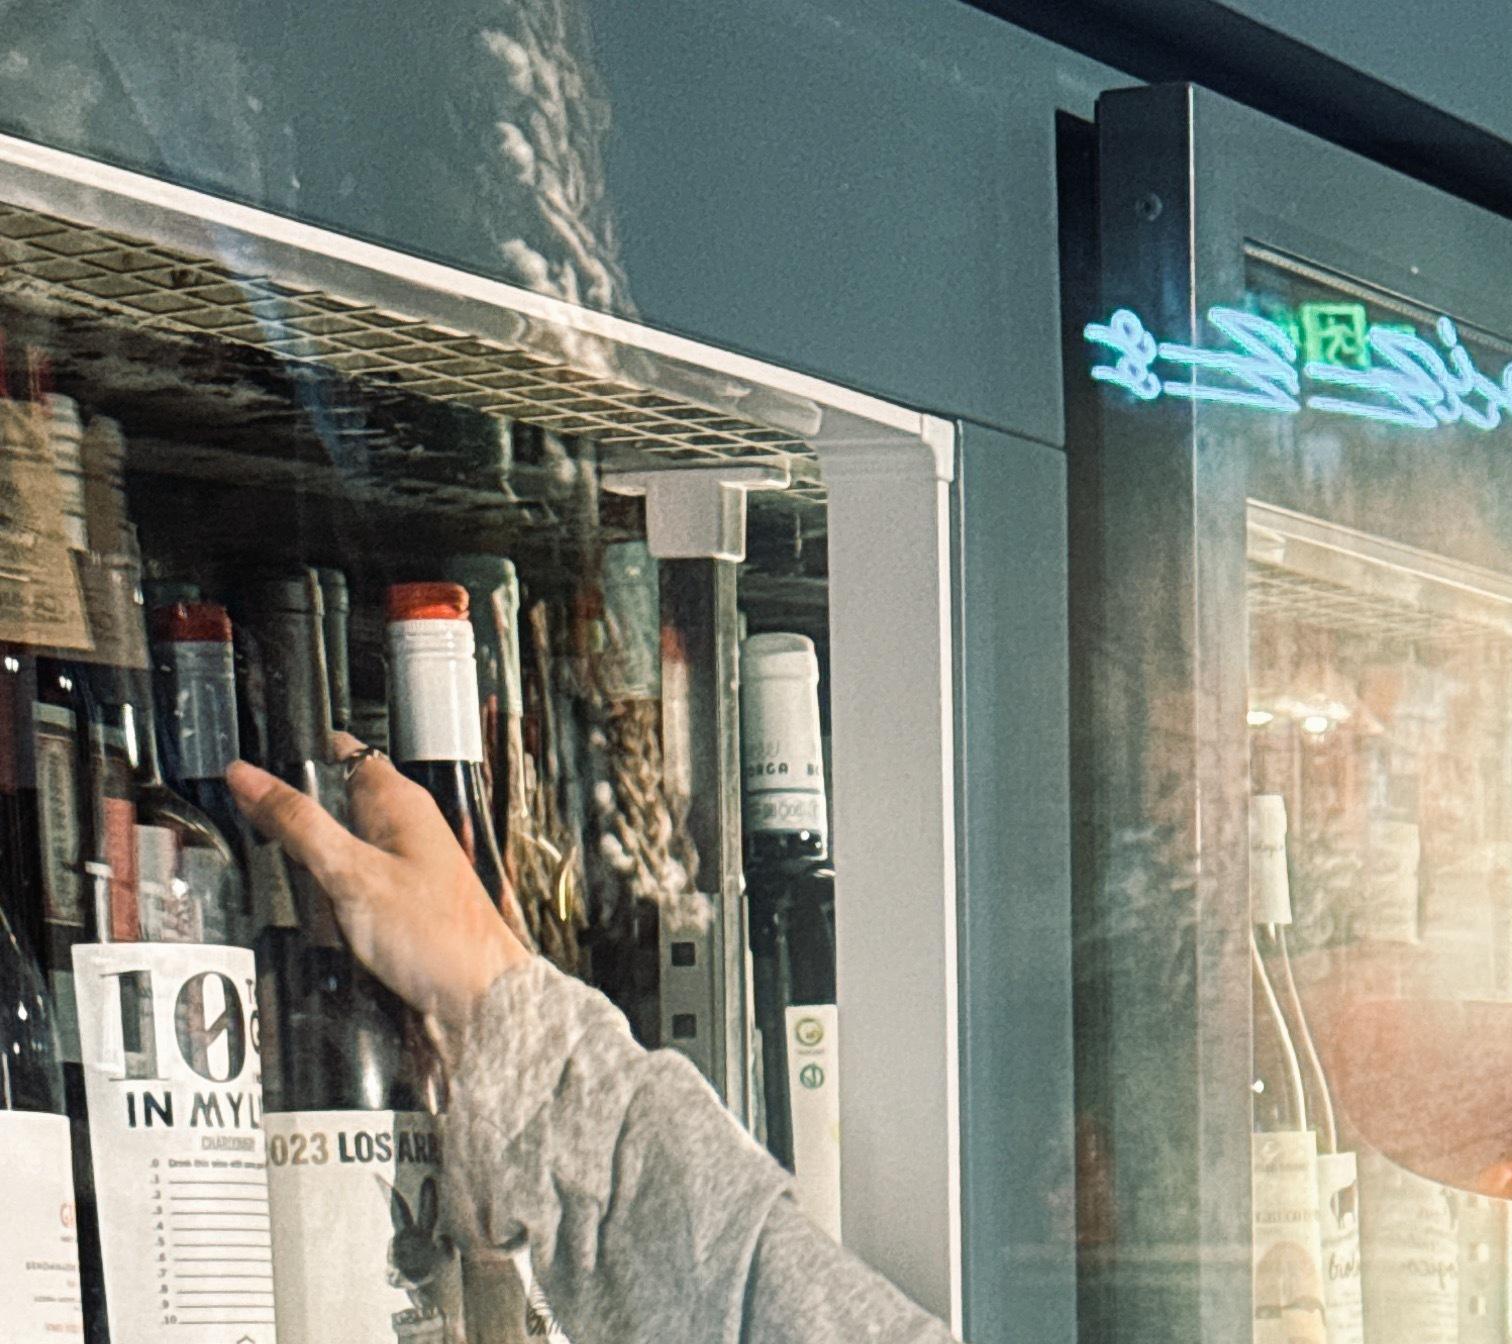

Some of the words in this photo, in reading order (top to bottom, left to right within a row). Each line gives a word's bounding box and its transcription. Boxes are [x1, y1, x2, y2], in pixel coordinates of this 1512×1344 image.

[100, 969, 247, 1083] 10
[127, 1091, 174, 1129] IN
[265, 1131, 330, 1166] 023
[337, 1131, 393, 1163] LOS
